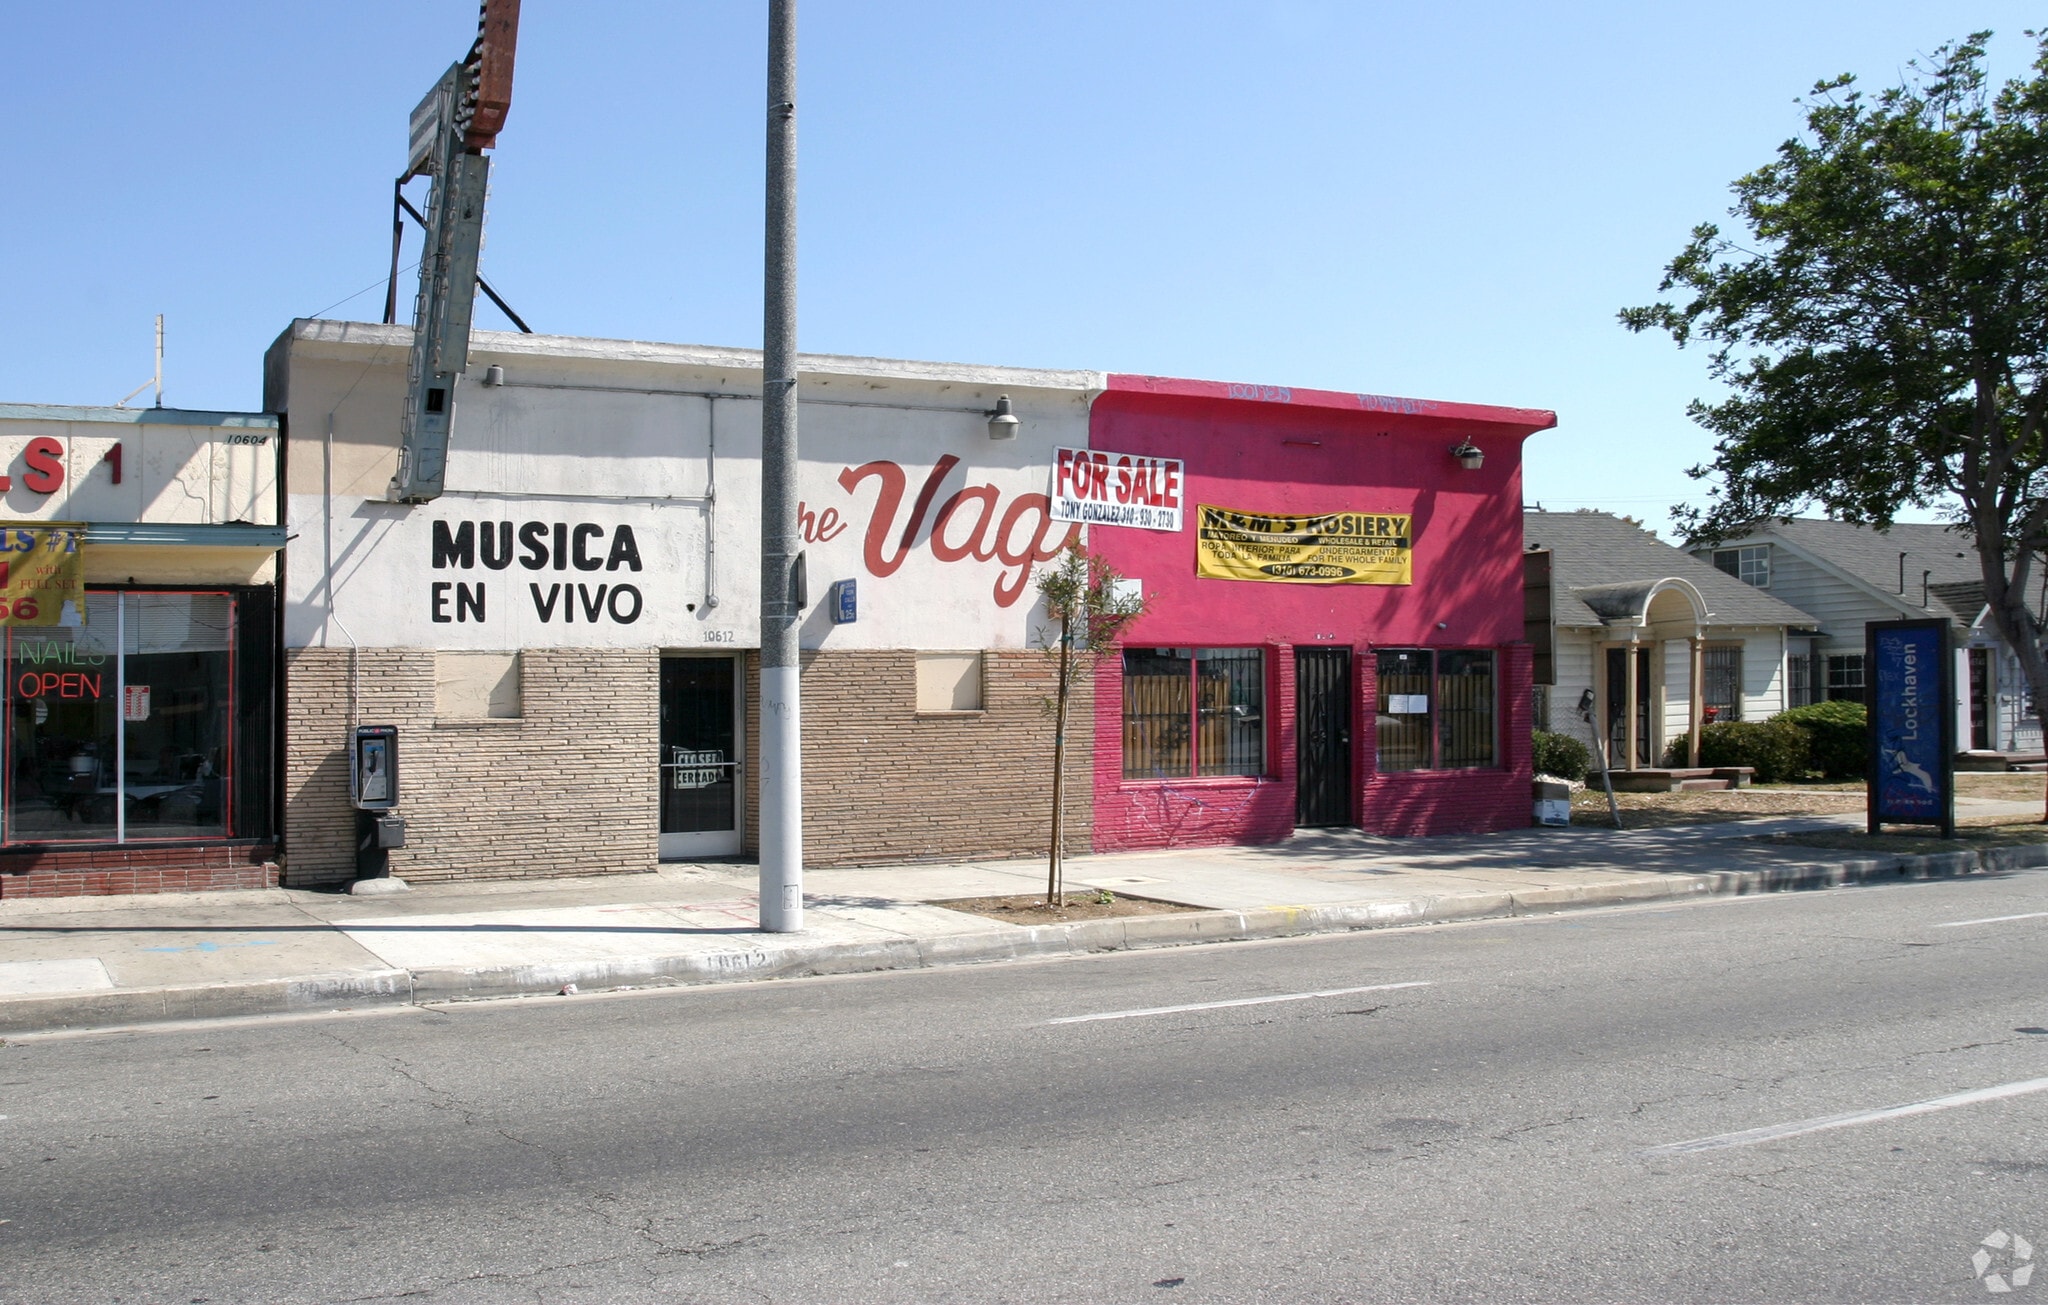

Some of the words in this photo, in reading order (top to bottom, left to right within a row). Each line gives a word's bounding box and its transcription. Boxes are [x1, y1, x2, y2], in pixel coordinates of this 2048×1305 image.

[227, 434, 268, 446] 10604
[0, 437, 64, 493] S
[104, 442, 122, 484] 1
[1057, 448, 1109, 502] FOR
[1115, 456, 1179, 508] SALE
[1061, 501, 1081, 519] TONY
[1083, 503, 1120, 523] GONZALEZ
[798, 501, 848, 544] he
[1306, 515, 1405, 536] HOSIERY
[1207, 530, 1248, 542] MAYOREO
[1259, 535, 1299, 545] MENUDEO
[1318, 537, 1363, 546] WHOLESALE
[1371, 539, 1398, 547] RETAIL
[432, 520, 643, 572] MUSICA
[1202, 541, 1226, 552] ROPA
[1279, 546, 1301, 556] PARA
[1319, 547, 1396, 557] UNDERGARMENTS
[1212, 550, 1236, 560] TODA
[1241, 553, 1253, 561] LA
[1257, 553, 1292, 563] FAMILIA
[1307, 555, 1325, 563] FOR
[1327, 555, 1343, 563] THE
[1345, 556, 1376, 564] WHOLE
[1378, 557, 1408, 566] FAMILY
[36, 564, 62, 575] with
[1271, 565, 1296, 575] (310)
[1298, 566, 1343, 577] 673-0996
[20, 579, 51, 590] FULL
[55, 578, 76, 590] SET
[432, 582, 486, 623] EN
[529, 583, 643, 625] VIVO
[703, 631, 734, 642] 10612
[20, 641, 106, 666] NAILS
[18, 672, 101, 698] OPEN
[1901, 643, 1918, 741] Lockhaven
